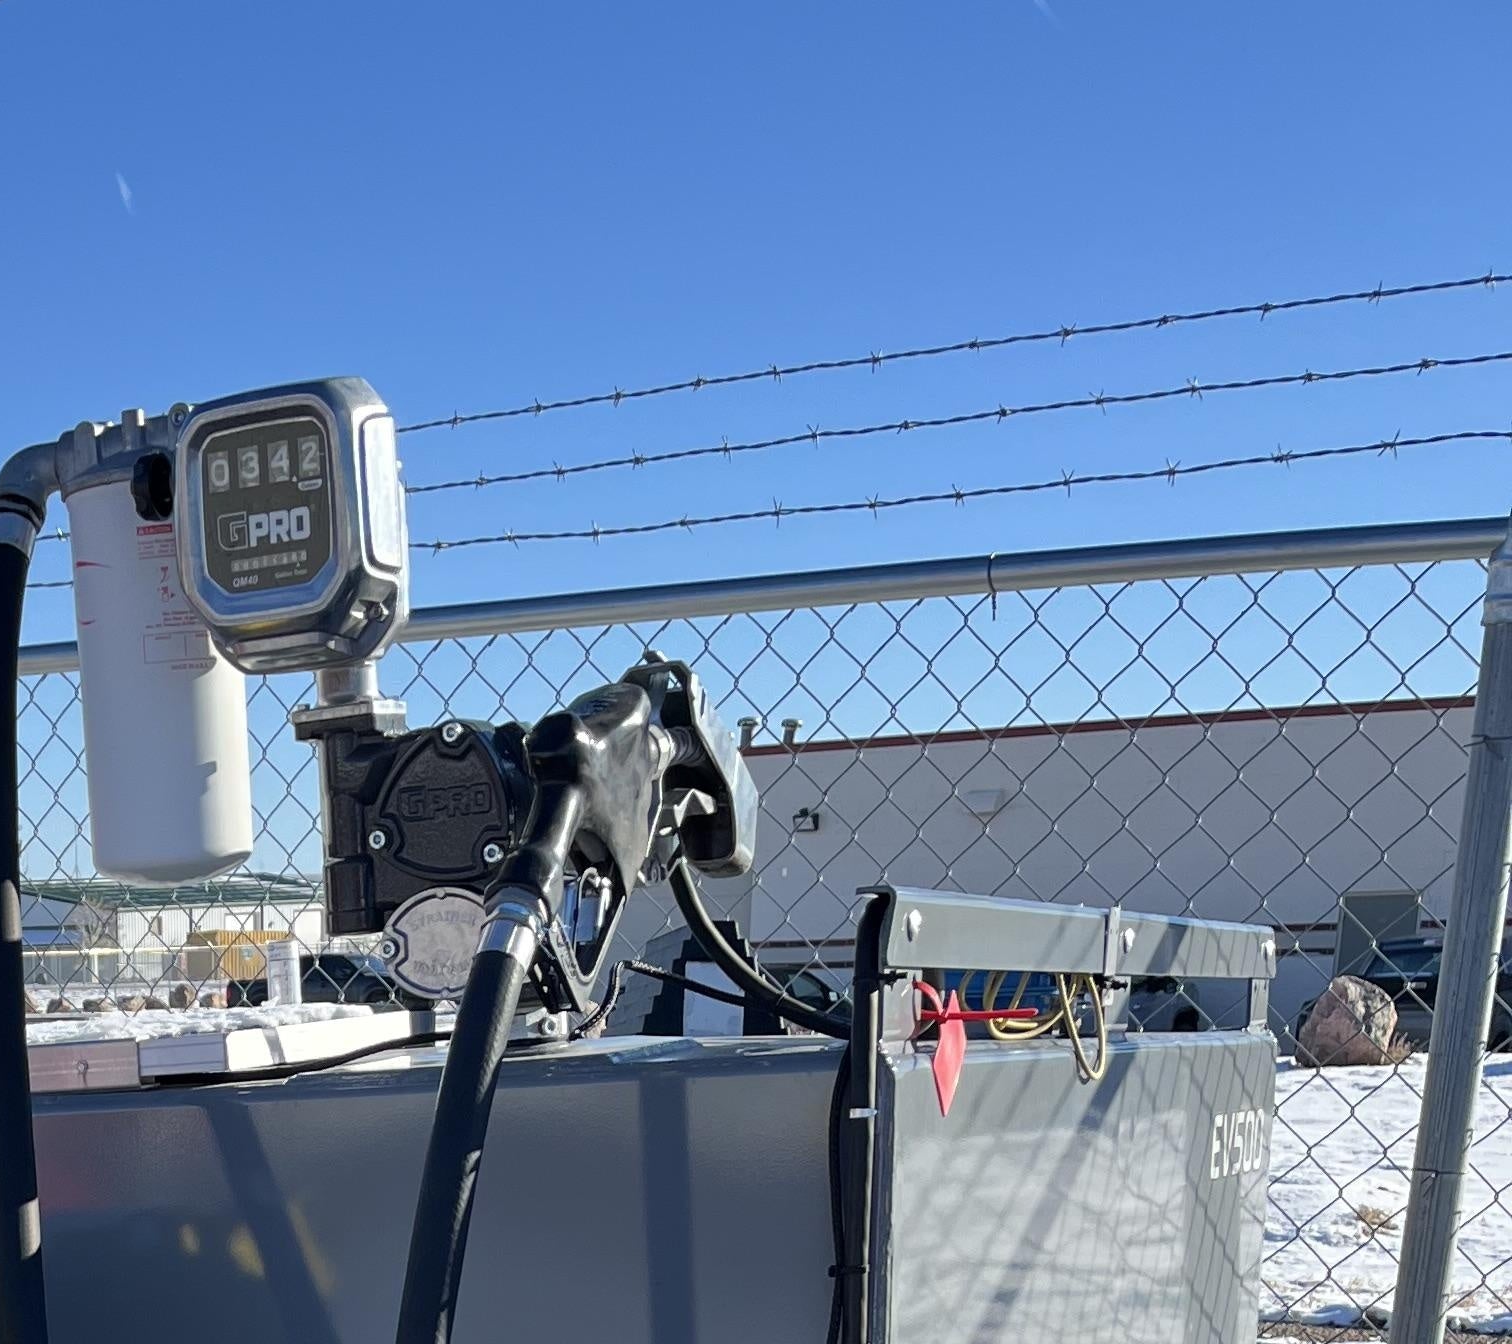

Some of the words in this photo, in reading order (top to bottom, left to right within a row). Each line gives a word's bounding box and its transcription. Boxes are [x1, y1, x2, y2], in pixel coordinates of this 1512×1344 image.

[217, 506, 311, 550] GPRO
[399, 783, 492, 822] GPRO
[1210, 1109, 1265, 1179] EV500
